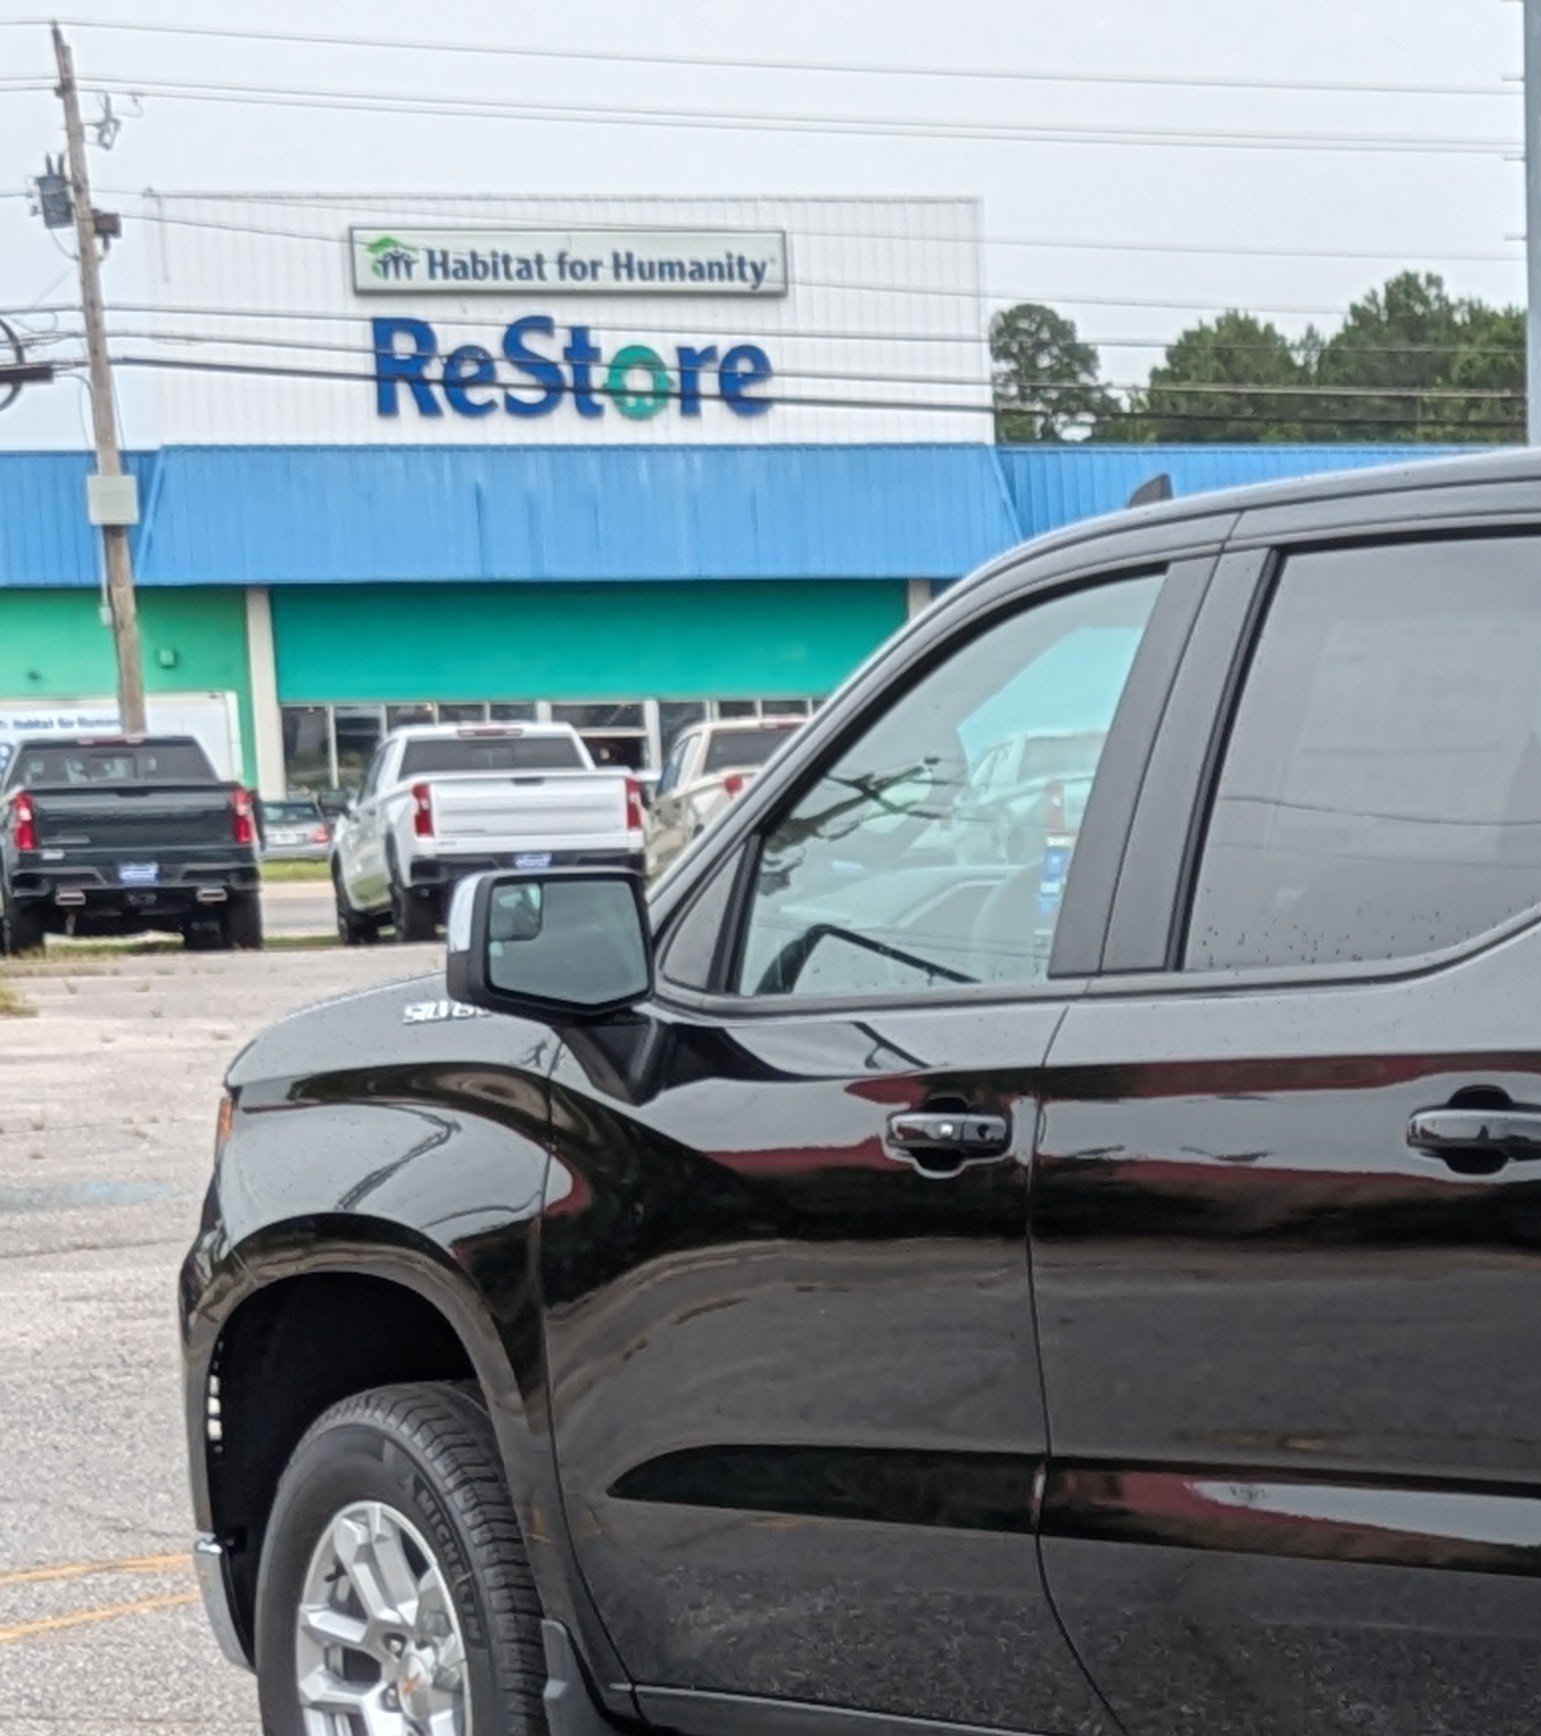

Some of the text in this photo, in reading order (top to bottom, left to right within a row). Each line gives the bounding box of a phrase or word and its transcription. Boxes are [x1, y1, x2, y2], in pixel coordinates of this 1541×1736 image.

[427, 248, 768, 290] Habitat for Humanity
[371, 315, 774, 420] ReStore
